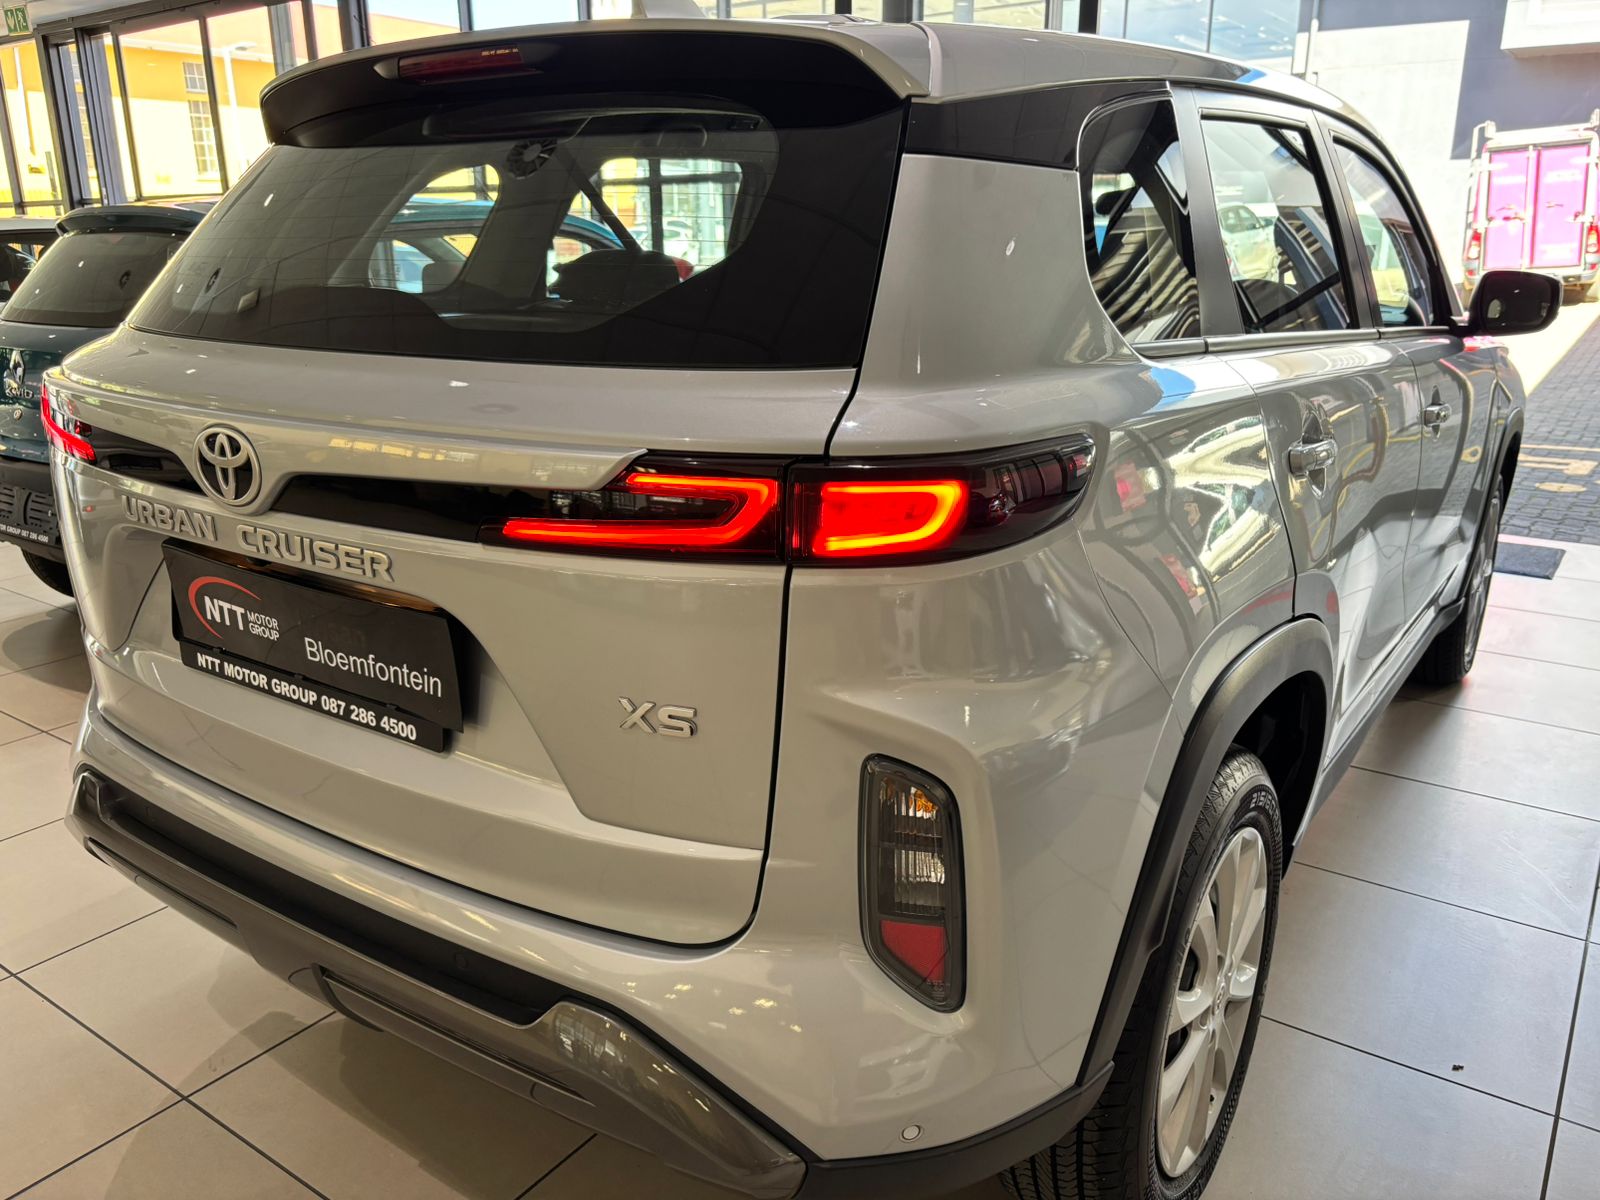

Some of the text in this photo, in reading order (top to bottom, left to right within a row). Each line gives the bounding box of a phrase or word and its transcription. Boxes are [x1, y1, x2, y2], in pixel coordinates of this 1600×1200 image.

[120, 494, 395, 582] URBAN CRUISER
[203, 595, 245, 631] NTT
[246, 609, 280, 631] MOTOR
[248, 622, 280, 641] GROUP
[304, 637, 442, 698] Bloemfontein
[196, 652, 417, 741] NTT MOTOR GROUP 087 286 4500
[618, 696, 698, 738] XS
